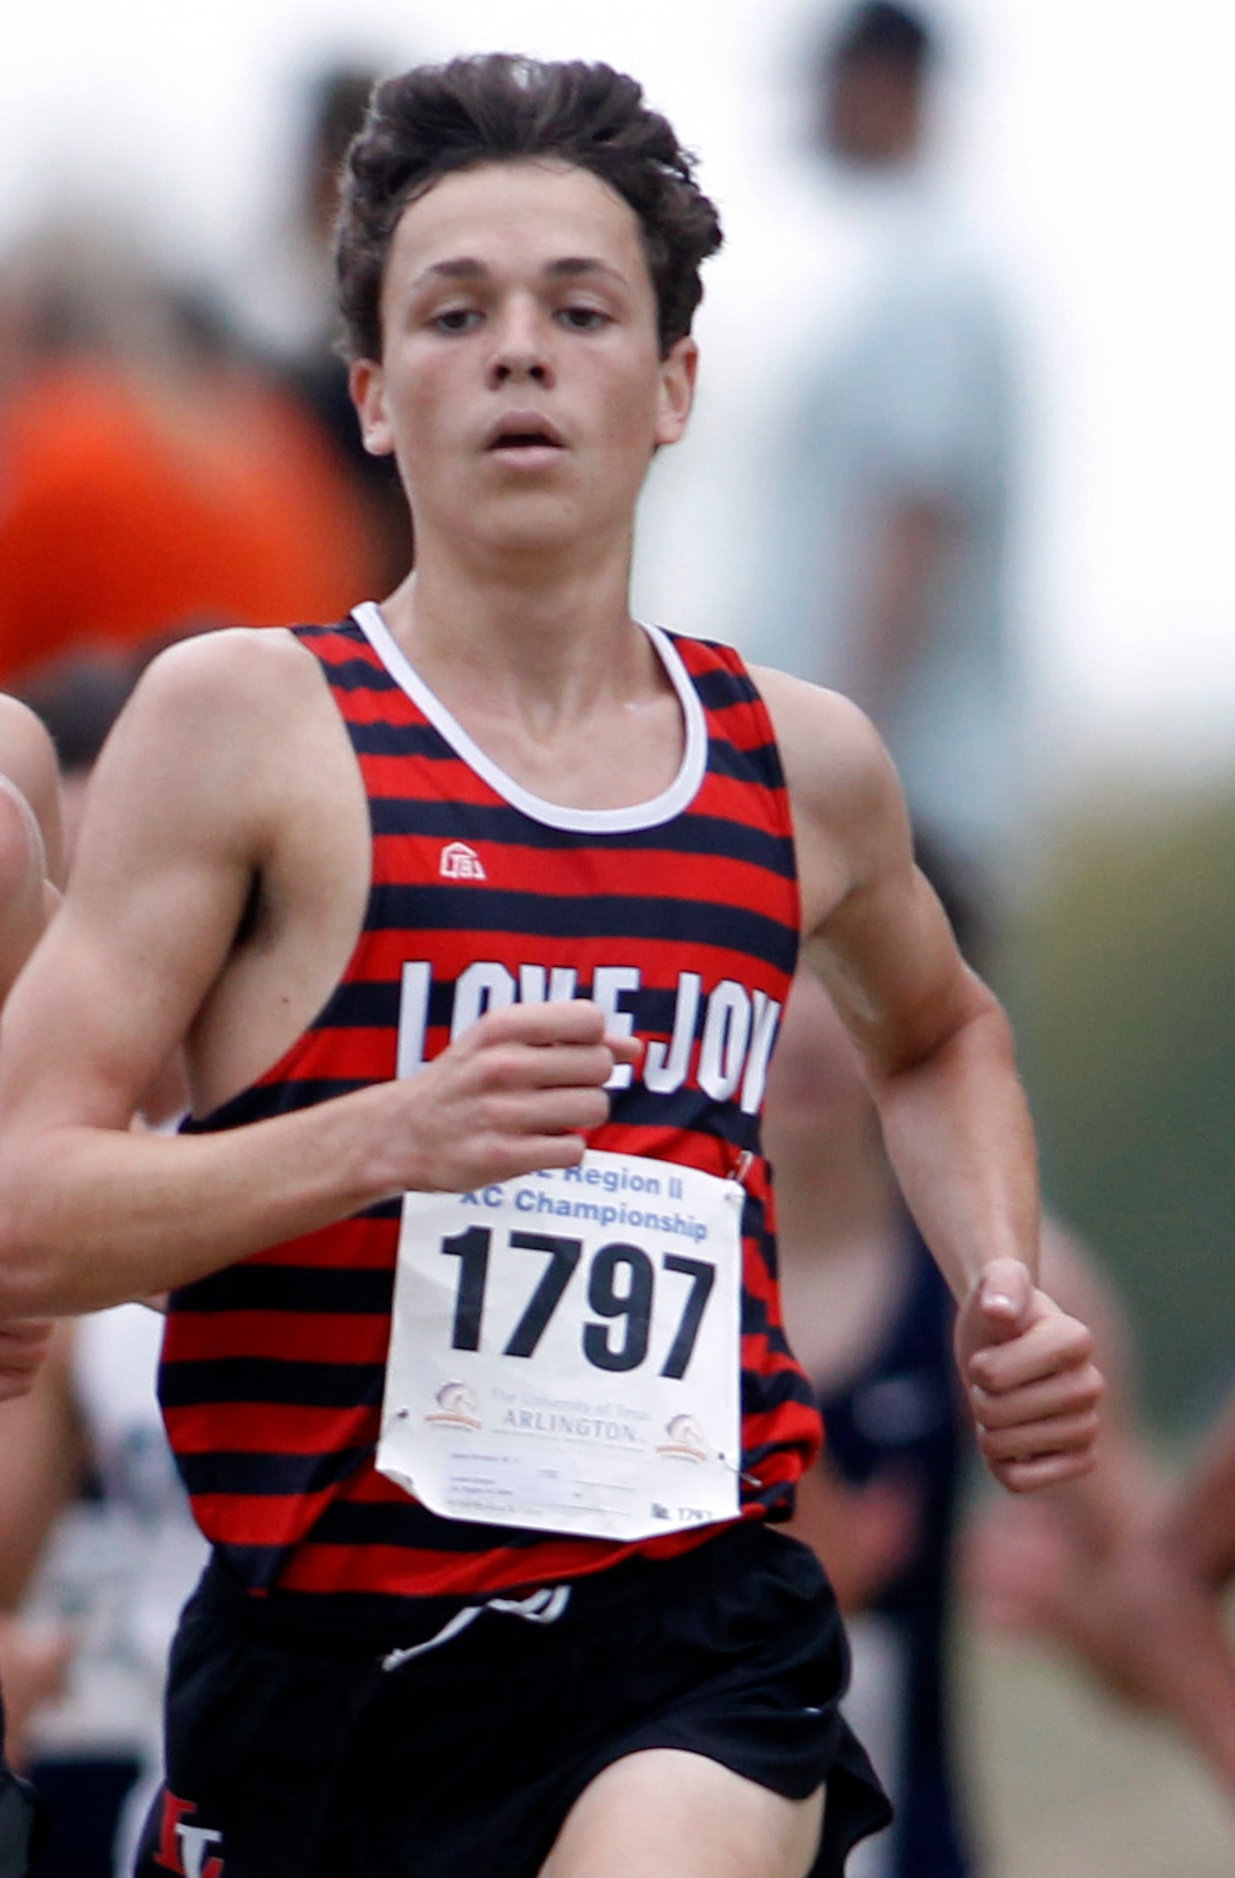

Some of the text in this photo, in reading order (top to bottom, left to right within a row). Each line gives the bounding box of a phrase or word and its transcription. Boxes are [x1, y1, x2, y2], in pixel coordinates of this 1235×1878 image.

[563, 1165, 660, 1194] Region
[515, 1189, 708, 1243] Championship
[441, 1224, 717, 1381] 1797
[504, 1408, 637, 1442] ARLINGTON
